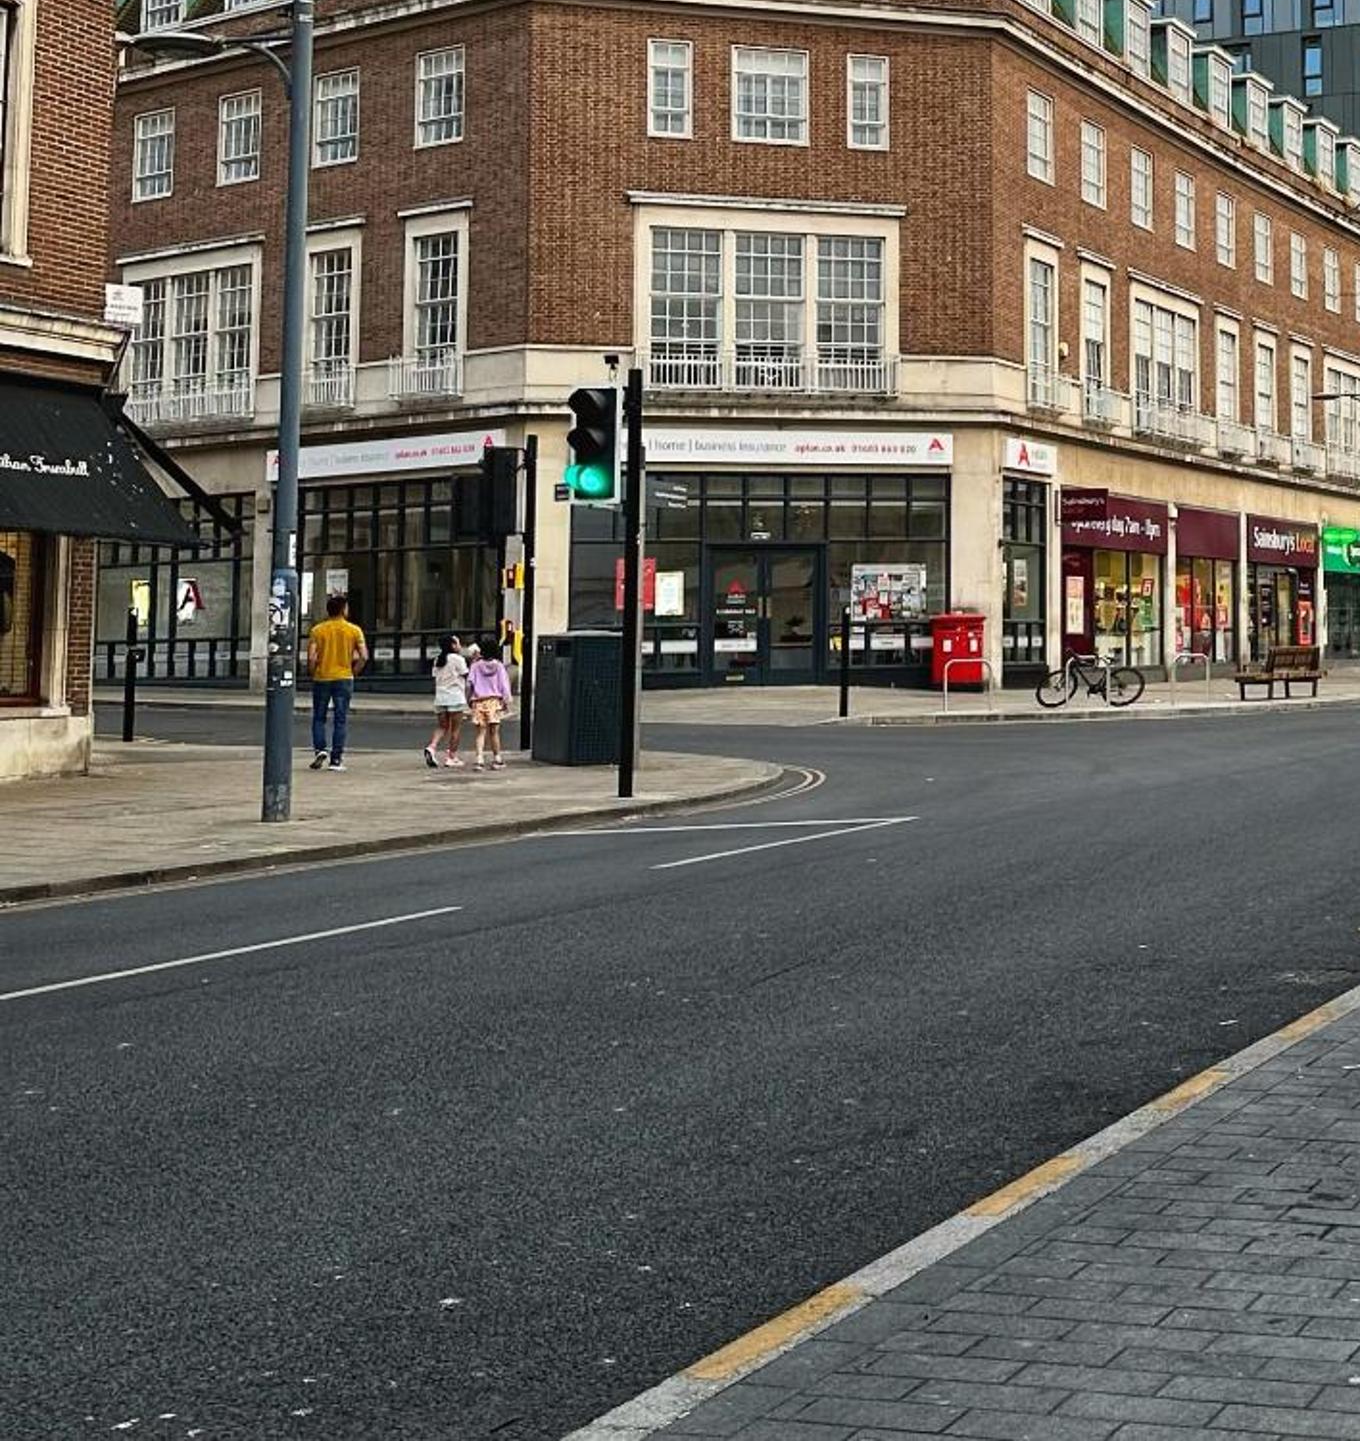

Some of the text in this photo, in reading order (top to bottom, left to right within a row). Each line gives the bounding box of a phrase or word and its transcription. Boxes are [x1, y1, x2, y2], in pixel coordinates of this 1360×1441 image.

[1112, 514, 1124, 537] day
[1124, 515, 1140, 536] 7am
[1253, 526, 1315, 556] Sainsbury's Local
